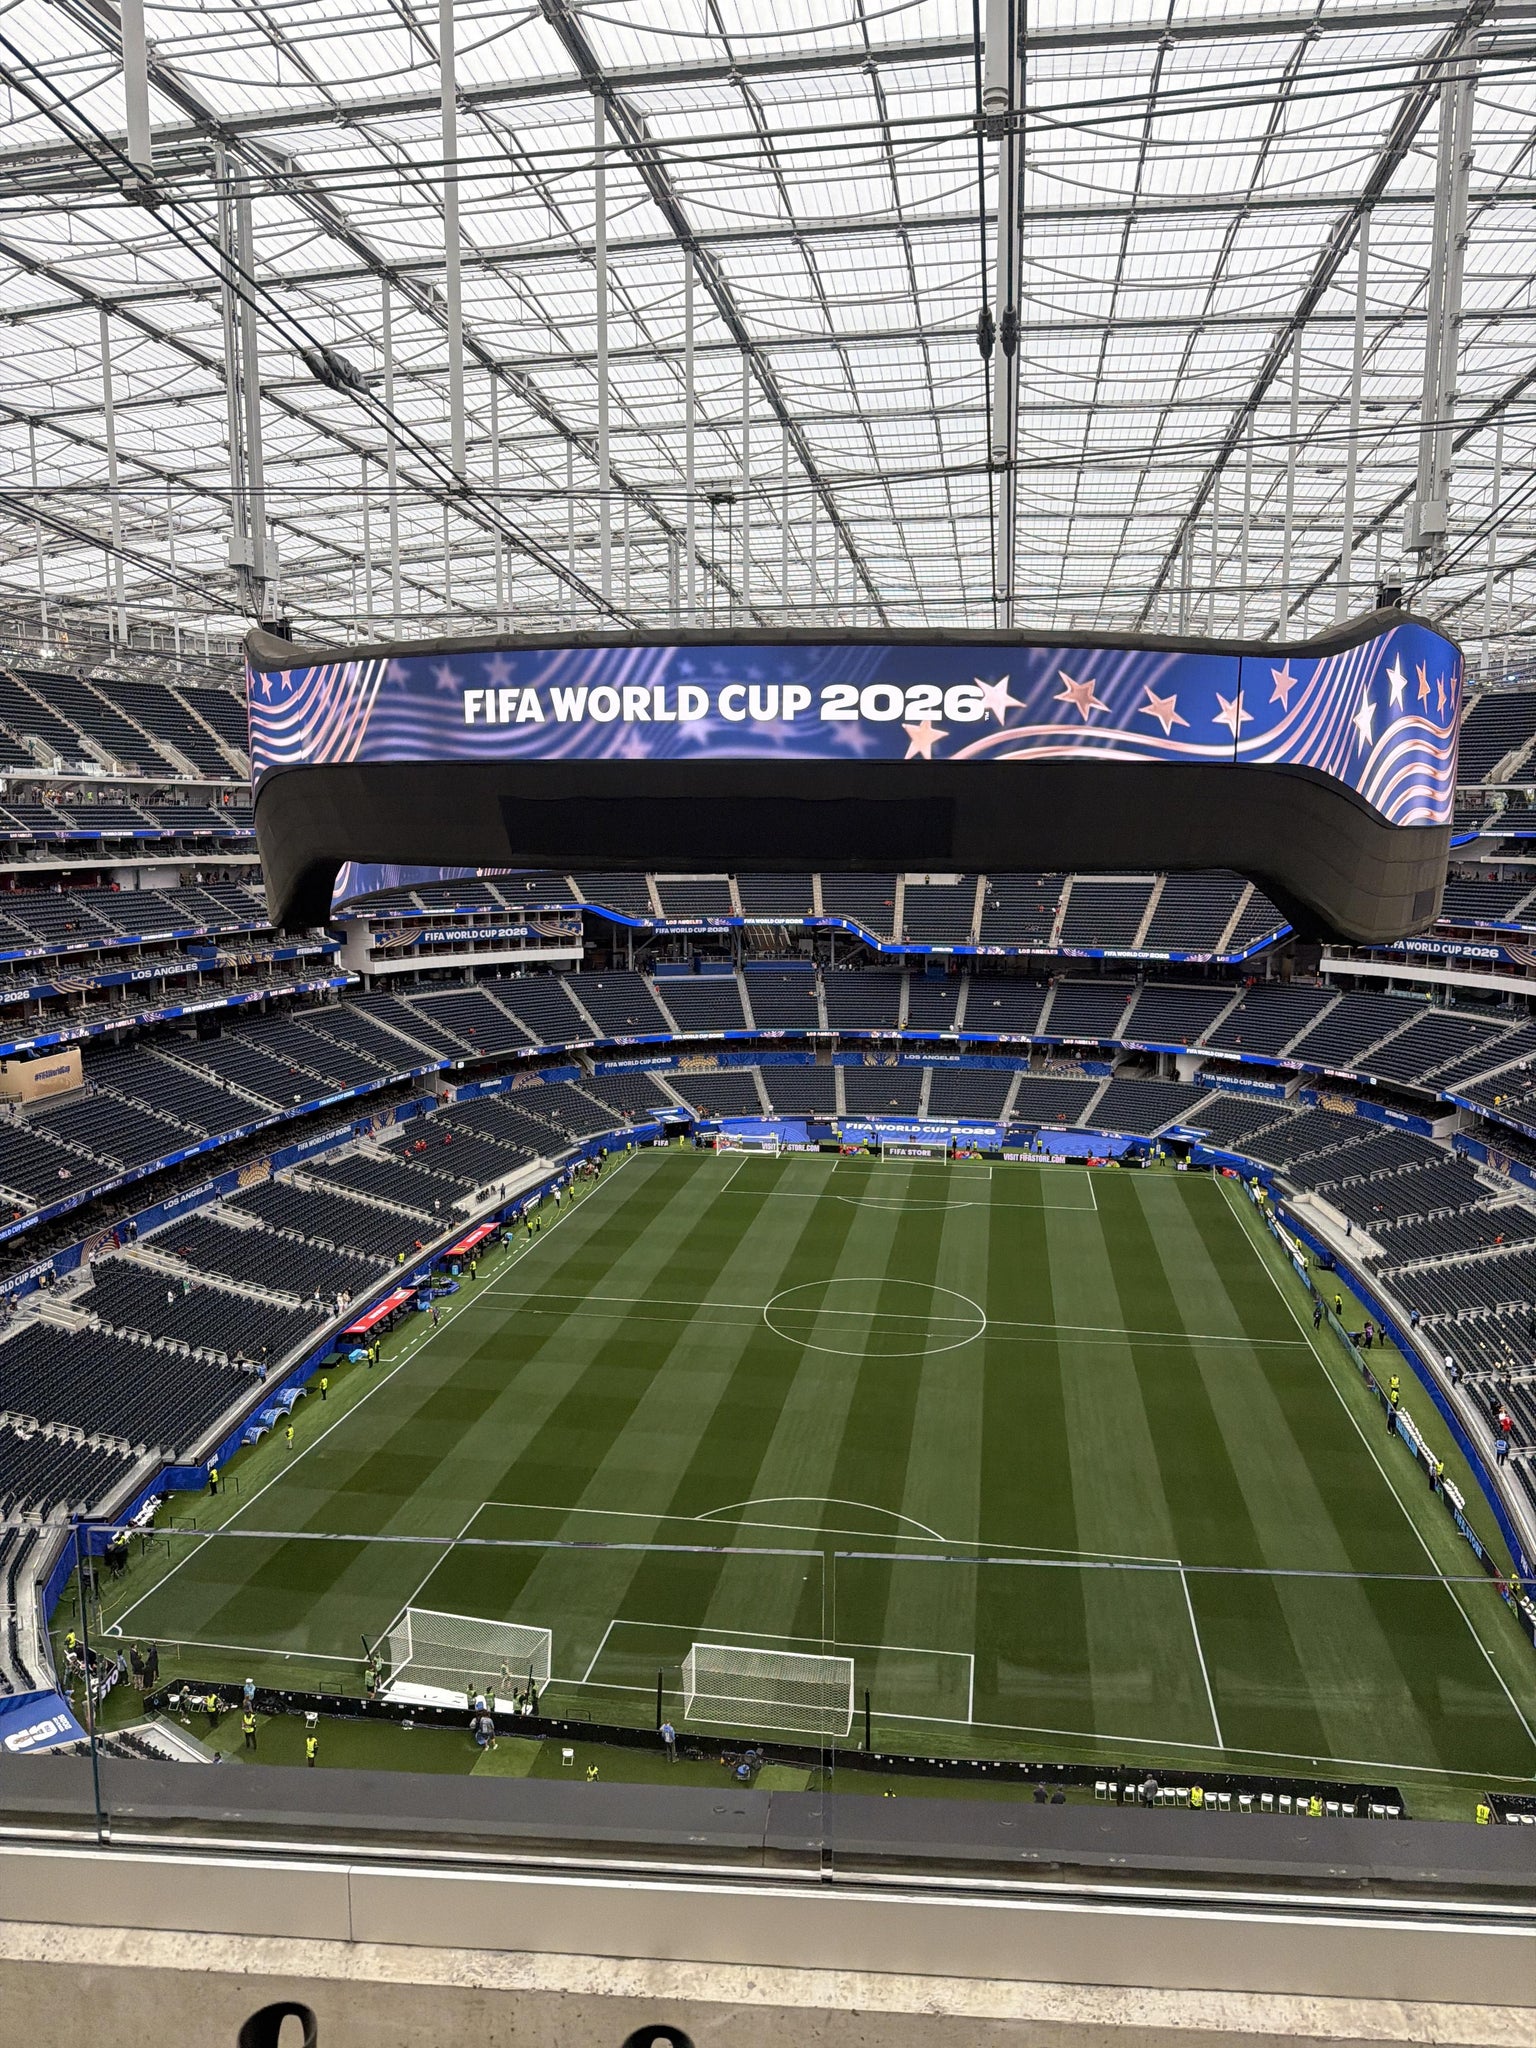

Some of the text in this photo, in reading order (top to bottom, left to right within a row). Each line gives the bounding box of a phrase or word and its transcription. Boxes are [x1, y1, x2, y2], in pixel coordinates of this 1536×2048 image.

[464, 688, 545, 724] FIFA
[550, 686, 709, 723] WORLD
[718, 684, 812, 722] CUP
[425, 928, 528, 941] FIFA WORLD CUP 2026
[1406, 941, 1440, 953] WORLD
[1441, 944, 1461, 955] CUP
[1462, 946, 1499, 958] 2026
[131, 963, 198, 980] LOS ANGELES
[4, 990, 30, 1003] 2026
[1216, 1075, 1239, 1084] WORLD
[875, 1124, 920, 1132] WORLD
[922, 1126, 949, 1134] CUP
[950, 1127, 997, 1135] 2026
[297, 1142, 309, 1151] FIFA
[308, 1135, 325, 1147] WORLD
[325, 1131, 335, 1140] CUP
[653, 1139, 669, 1147] FIFA
[890, 1148, 931, 1157] FIFA STORE
[1003, 1153, 1019, 1161] VISIT
[163, 1182, 214, 1211] LOS ANGELES
[15, 1272, 29, 1286] CUP
[30, 1259, 54, 1279] 2026
